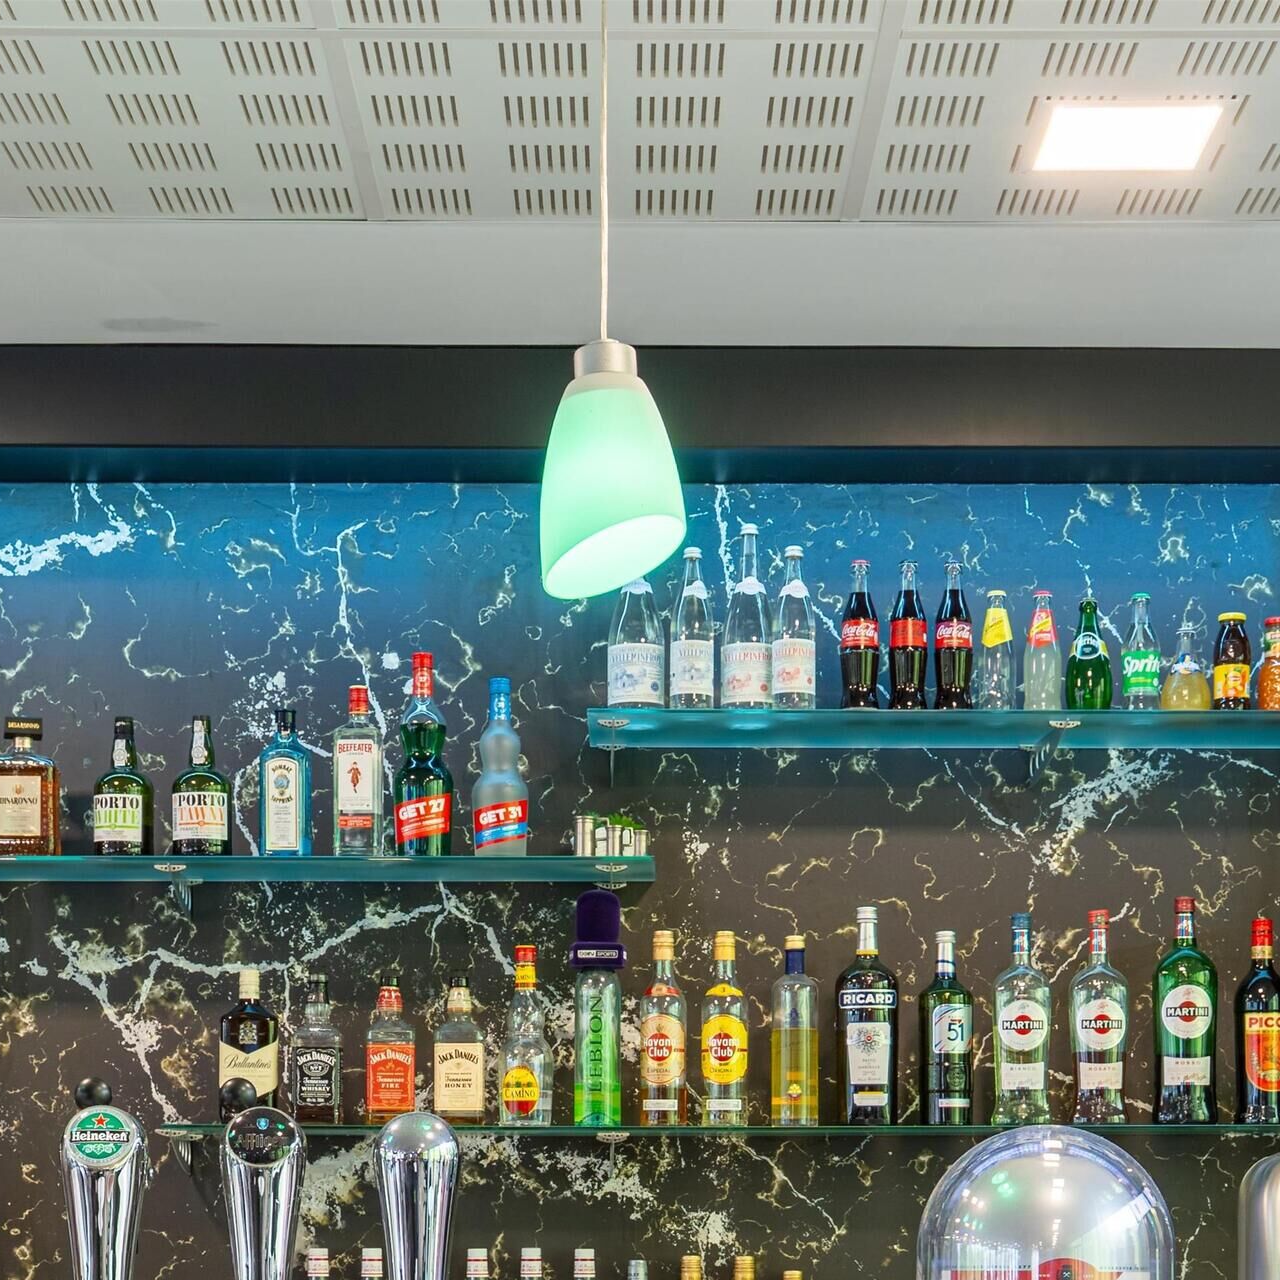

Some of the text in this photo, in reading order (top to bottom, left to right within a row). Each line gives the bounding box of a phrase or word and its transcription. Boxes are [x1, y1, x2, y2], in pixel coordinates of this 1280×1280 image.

[841, 623, 875, 639] Coca-Cola
[936, 623, 970, 639] Coca-Cola
[338, 743, 373, 754] BEEFEATER
[271, 764, 293, 773] BOMBAY
[0, 796, 38, 806] DISARONNO
[94, 795, 140, 810] PORTO
[178, 794, 226, 808] PORTO
[178, 806, 225, 822] TAWNY
[398, 797, 446, 821] GET 27
[479, 804, 523, 826] GET 31
[842, 993, 894, 1005] RICARD
[1166, 1006, 1209, 1017] MARTINI
[1002, 1019, 1044, 1030] MARTINI
[1081, 1019, 1122, 1030] MARTINI
[946, 1022, 965, 1042] 51
[589, 996, 603, 1093] LEBLON
[296, 1051, 337, 1066] JACK DANIEL'S
[370, 1049, 412, 1065] JACK DANIEL'S
[438, 1049, 479, 1065] JACK DANIEL'S
[648, 1047, 670, 1058] Club
[711, 1047, 734, 1058] Club
[224, 1055, 272, 1069] Ballantine's
[504, 1087, 536, 1098] CAMINO
[71, 1130, 130, 1142] Heineken
